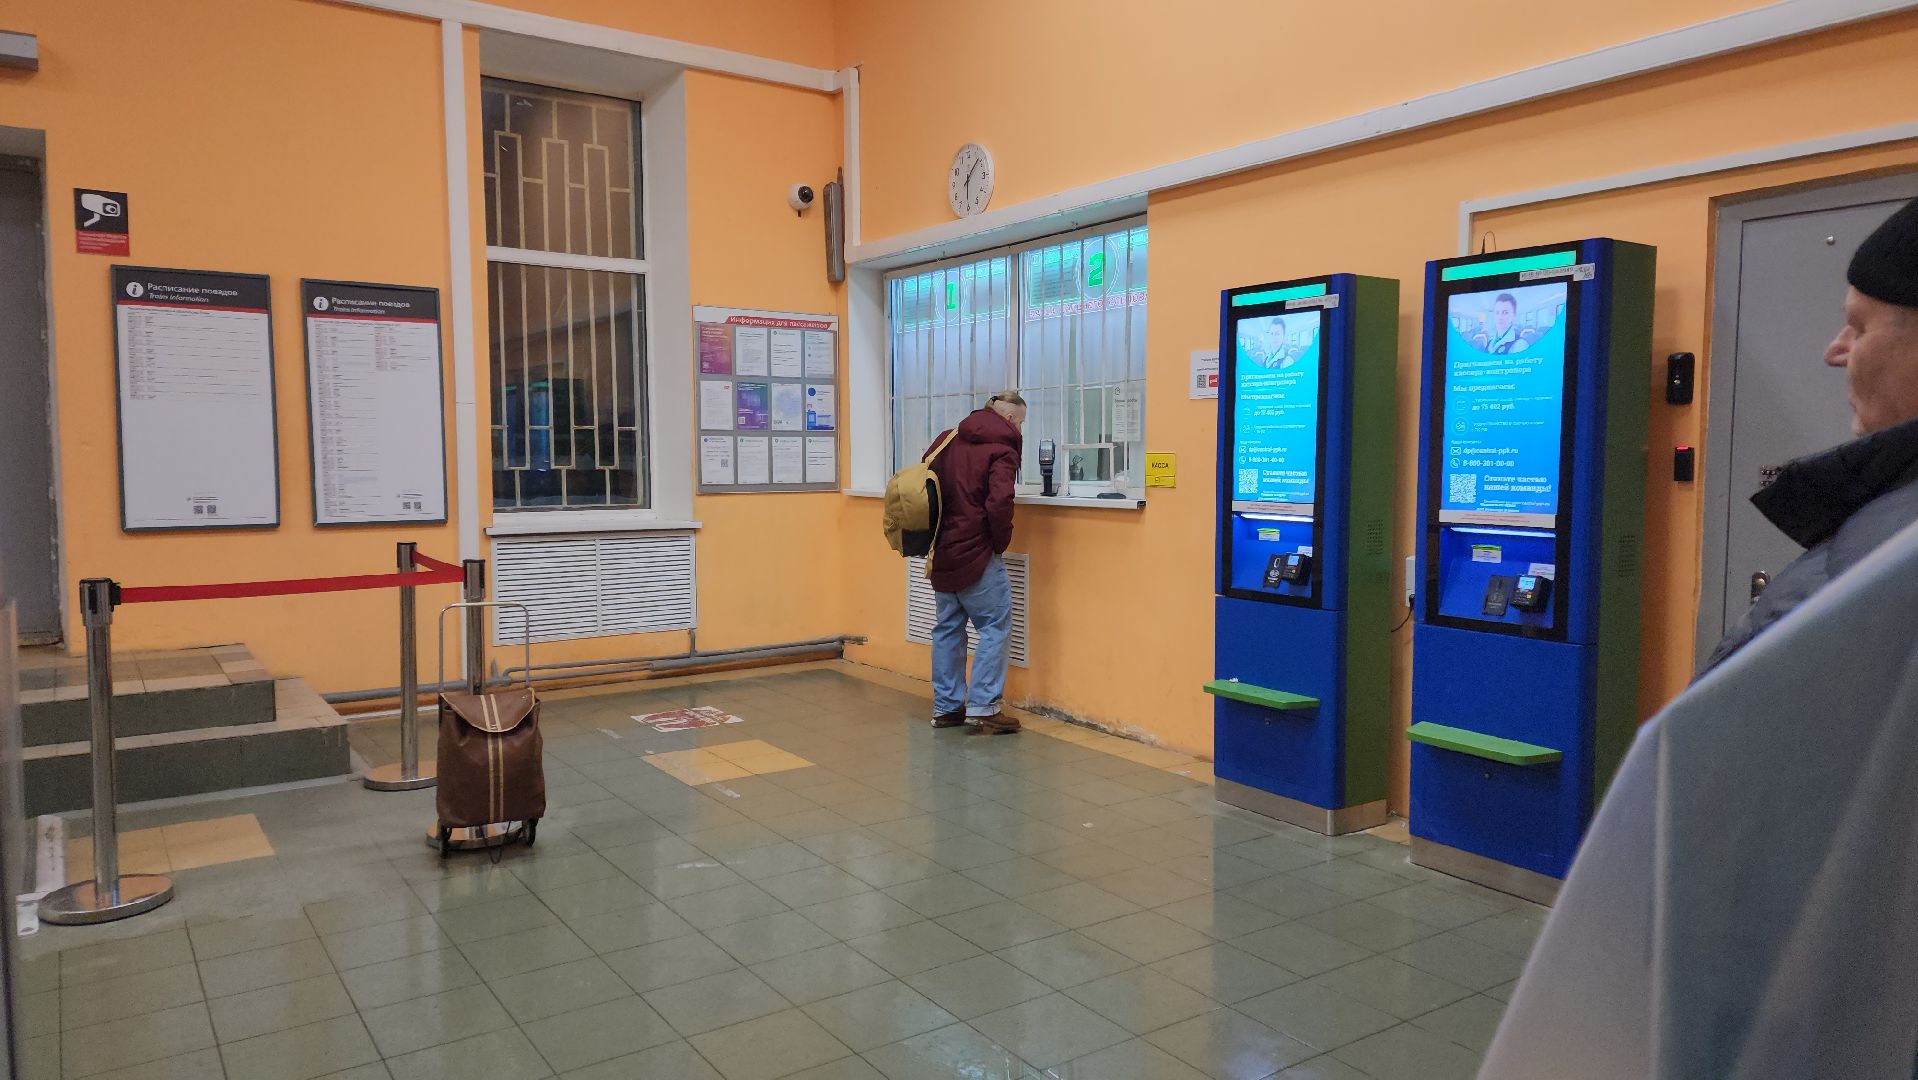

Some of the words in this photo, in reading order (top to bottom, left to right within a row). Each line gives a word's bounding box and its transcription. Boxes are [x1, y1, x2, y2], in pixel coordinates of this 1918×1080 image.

[1088, 252, 1104, 288] 2
[147, 282, 200, 294] Расписание
[201, 288, 238, 297] поездов
[946, 283, 956, 310] 1
[331, 296, 377, 306] Расписание
[378, 301, 411, 309] поездов
[730, 316, 775, 327] Информация
[789, 321, 828, 330] пассажиров
[1516, 357, 1544, 366] работу
[1517, 476, 1548, 484] частью
